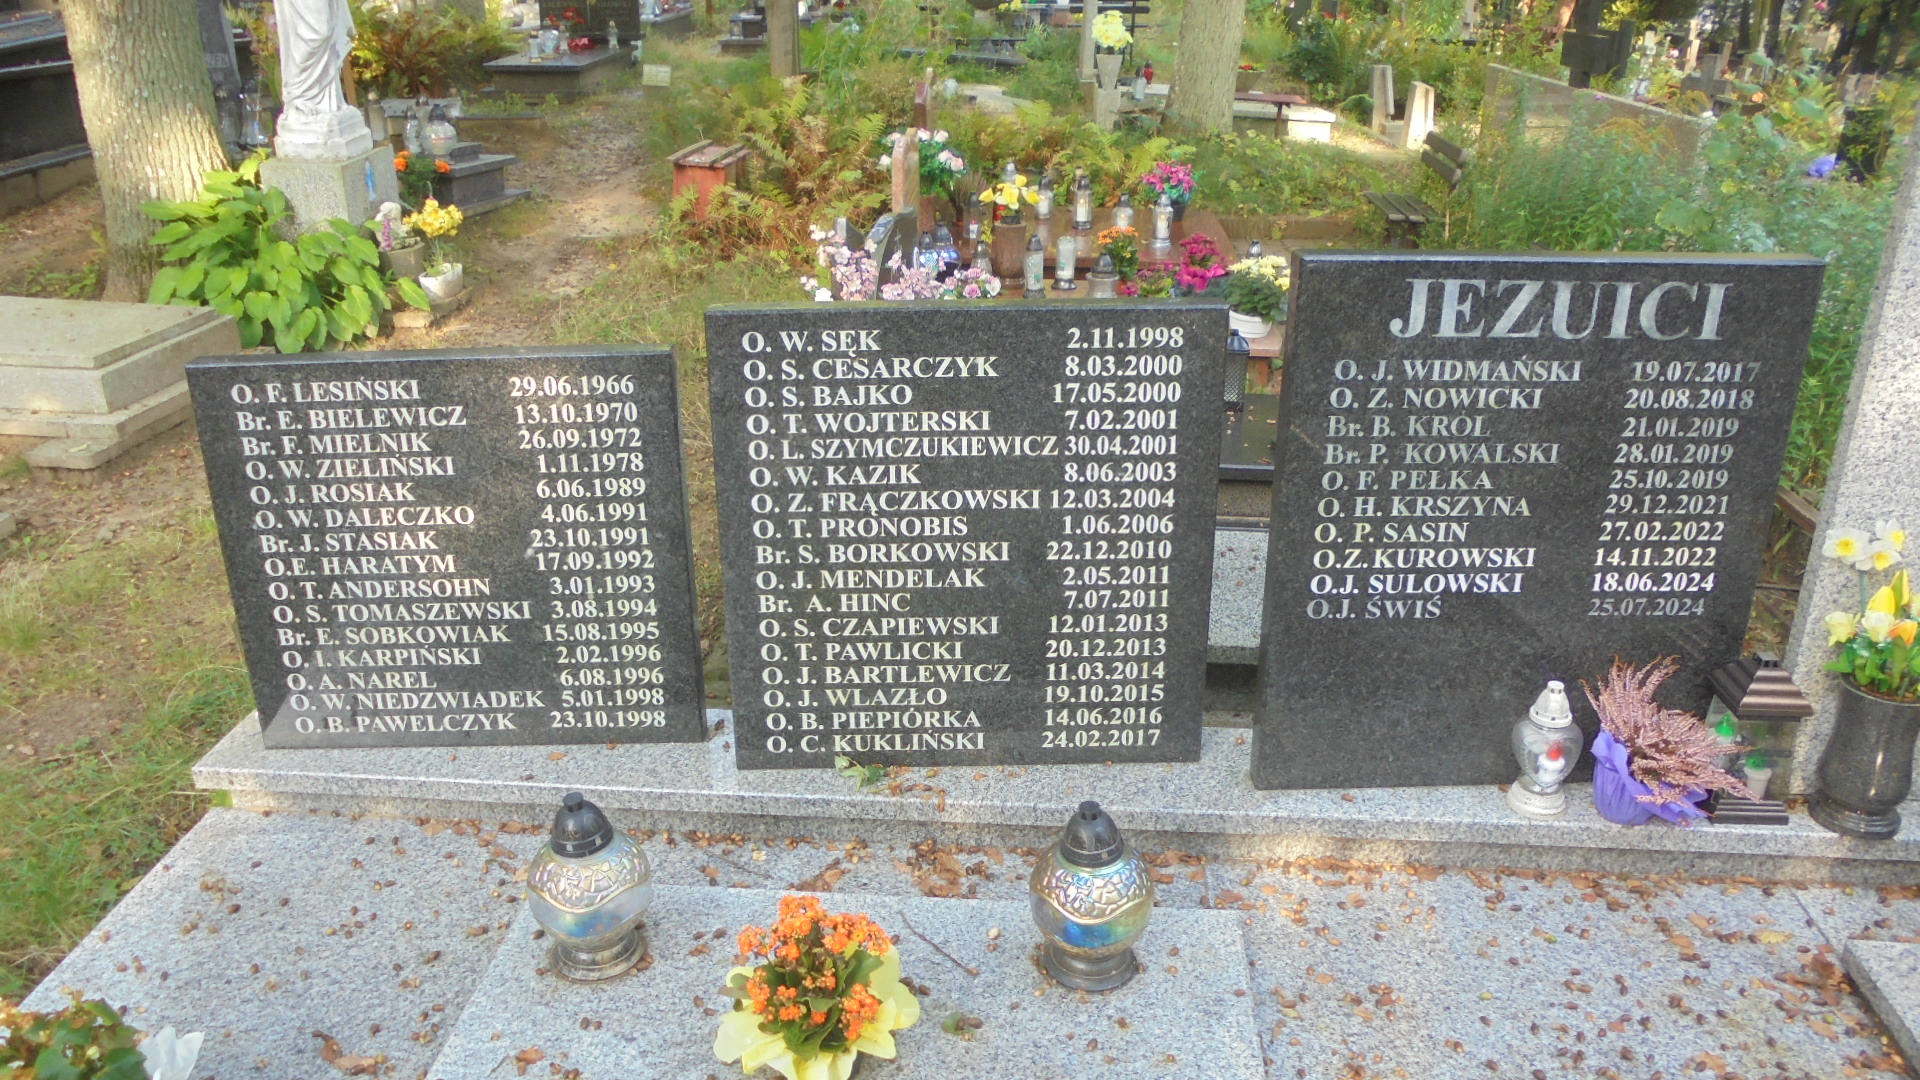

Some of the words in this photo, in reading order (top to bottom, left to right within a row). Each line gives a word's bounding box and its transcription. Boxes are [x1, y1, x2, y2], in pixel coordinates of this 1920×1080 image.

[1390, 279, 1732, 339] JEZUICI
[741, 331, 773, 353] O.
[778, 331, 814, 352] W.
[820, 330, 882, 356] SĘK
[1066, 326, 1185, 349] 2.11.1998
[742, 359, 774, 381] O.
[780, 359, 806, 381] S.
[811, 356, 1000, 380] CESARCZYK
[1064, 355, 1184, 376] 8.03.2000
[1333, 359, 1364, 380] O.
[1370, 360, 1394, 381] J.
[1402, 355, 1583, 381] WIDMAŃSKI
[1631, 361, 1758, 382] 19.07.2017
[230, 384, 261, 404] O.
[263, 383, 288, 403] F.
[291, 377, 422, 402] LESIŃSKI
[508, 374, 635, 397] 29.06.1966
[743, 386, 775, 407] O.
[781, 386, 806, 407] S.
[811, 384, 914, 406] BAJKO
[1052, 381, 1182, 403] 17.05.2000
[1329, 387, 1360, 408] O.
[1366, 388, 1394, 408] Z.
[1401, 388, 1544, 409] NOWICKI
[1623, 388, 1755, 409] 20.08.2018
[234, 411, 272, 431] Br.
[275, 410, 303, 430] E.
[307, 406, 468, 429] BIELEWICZ
[513, 402, 638, 424] 13.10.1970
[745, 414, 777, 435] O.
[782, 414, 808, 434] T.
[813, 410, 992, 433] WOJTERSKI
[1064, 409, 1178, 430] 7.02.2001
[1325, 416, 1365, 437] Br.
[1370, 416, 1396, 437] B.
[1620, 417, 1740, 437] 21.01.2019
[239, 437, 277, 456] Br.
[280, 436, 304, 455] F.
[307, 432, 433, 454] MIELNIK
[517, 426, 643, 449] 26.09.1972
[747, 440, 776, 460] O.
[780, 440, 805, 459] L.
[810, 435, 1060, 459] SZYMCZUKIEWICZ
[1063, 435, 1178, 455] 30.04.2001
[1322, 444, 1361, 464] Br.
[1367, 444, 1390, 464] P.
[1402, 443, 1561, 464] KOWALSKI
[1612, 443, 1734, 463] 28.01.2019
[244, 461, 274, 480] O.
[276, 460, 311, 479] W.
[315, 454, 457, 478] ZIELIŃSKI
[536, 452, 645, 473] 1.11.1978
[748, 467, 779, 487] O.
[784, 466, 819, 486] W.
[825, 464, 922, 486] KAZIK
[1063, 461, 1177, 482] 8.06.2003
[249, 486, 279, 505] O.
[283, 485, 306, 504] J.
[309, 482, 417, 503] ROSIAK
[535, 477, 647, 498] 6.06.1989
[1321, 471, 1350, 490] O.
[1356, 470, 1379, 490] F.
[1389, 470, 1495, 490] PEŁKA
[1608, 469, 1729, 489] 25.10.2019
[750, 493, 781, 513] O.
[787, 493, 814, 512] Z.
[820, 489, 1042, 516] FRĄCZKOWSKI
[1049, 488, 1176, 509] 12.03.2004
[1317, 497, 1346, 517] O.
[1352, 496, 1383, 517] H.
[1389, 496, 1532, 516] KRSZYNA
[1603, 494, 1729, 514] 29.12.2021
[254, 510, 284, 530] O.
[286, 509, 319, 528] W.
[323, 506, 476, 527] DALECZKO
[540, 502, 649, 523] 4.06.1991
[752, 519, 783, 539] O.
[787, 519, 813, 538] T.
[819, 516, 969, 538] PRONOBIS
[1062, 514, 1175, 534] 1.06.2006
[258, 535, 295, 553] Br.
[299, 534, 321, 552] J.
[324, 531, 440, 551] STASIAK
[529, 527, 650, 547] 23.10.1991
[1313, 522, 1344, 543] O.
[1351, 523, 1375, 543] P.
[1382, 522, 1471, 543] SASIN
[1597, 521, 1725, 541] 27.02.2022
[754, 545, 791, 564] Br.
[797, 545, 821, 564] S.
[827, 541, 1011, 563] BORKOWSKI
[1045, 540, 1173, 560] 22.12.2010
[267, 582, 296, 600] O.
[298, 581, 324, 599] T.
[328, 578, 491, 599] ANDERSOHN
[549, 575, 656, 595] 3.01.1993
[755, 571, 785, 590] O.
[790, 570, 813, 589] J.
[819, 568, 987, 589] MENDELAK
[1062, 565, 1171, 585] 2.05.2011
[272, 605, 301, 624] O.
[304, 605, 328, 623] S.
[331, 601, 533, 622] TOMASZEWSKI
[550, 598, 658, 619] 3.08.1994
[757, 595, 794, 613] Br.
[804, 594, 833, 612] A.
[838, 593, 911, 612] HINC
[1063, 589, 1170, 609] 7.07.2011
[275, 628, 312, 646] Br.
[314, 628, 341, 645] E.
[344, 625, 512, 645] SOBKOWIAK
[541, 622, 661, 641] 15.08.1995
[758, 619, 788, 638] O.
[793, 618, 816, 637] S.
[821, 616, 1000, 637] CZAPIEWSKI
[1048, 613, 1169, 633] 12.01.2013
[760, 643, 789, 662] O.
[793, 643, 818, 661] T.
[823, 641, 964, 661] PAWLICKI
[1044, 637, 1167, 658] 20.12.2013
[285, 673, 314, 690] O.
[318, 674, 343, 689] A.
[346, 671, 438, 689] NAREL
[559, 667, 665, 686] 6.08.1996
[761, 667, 791, 685] O.
[795, 666, 818, 684] J.
[823, 664, 1012, 684] BARTLEWICZ
[1045, 661, 1166, 681] 11.03.2014
[289, 694, 317, 710] O.
[320, 694, 352, 710] W.
[355, 690, 546, 709] NIEDZWIADEK
[561, 688, 665, 707] 5.01.1998
[762, 690, 792, 707] O.
[797, 689, 819, 707] J.
[824, 688, 948, 706] WLAZŁO
[1043, 684, 1165, 703] 19.10.2015
[294, 717, 322, 733] O.
[327, 717, 350, 733] B.
[356, 713, 518, 732] PAWELCZYK
[549, 710, 667, 728] 23.10.1998
[765, 713, 794, 731] O.
[798, 713, 825, 730] B.
[830, 708, 982, 729] PIEPIÓRKA
[1044, 706, 1163, 726] 14.06.2016
[765, 736, 794, 753] O.
[799, 735, 827, 753] C.
[832, 730, 986, 752] KUKLIŃSKI
[1040, 729, 1161, 748] 24.02.2017
